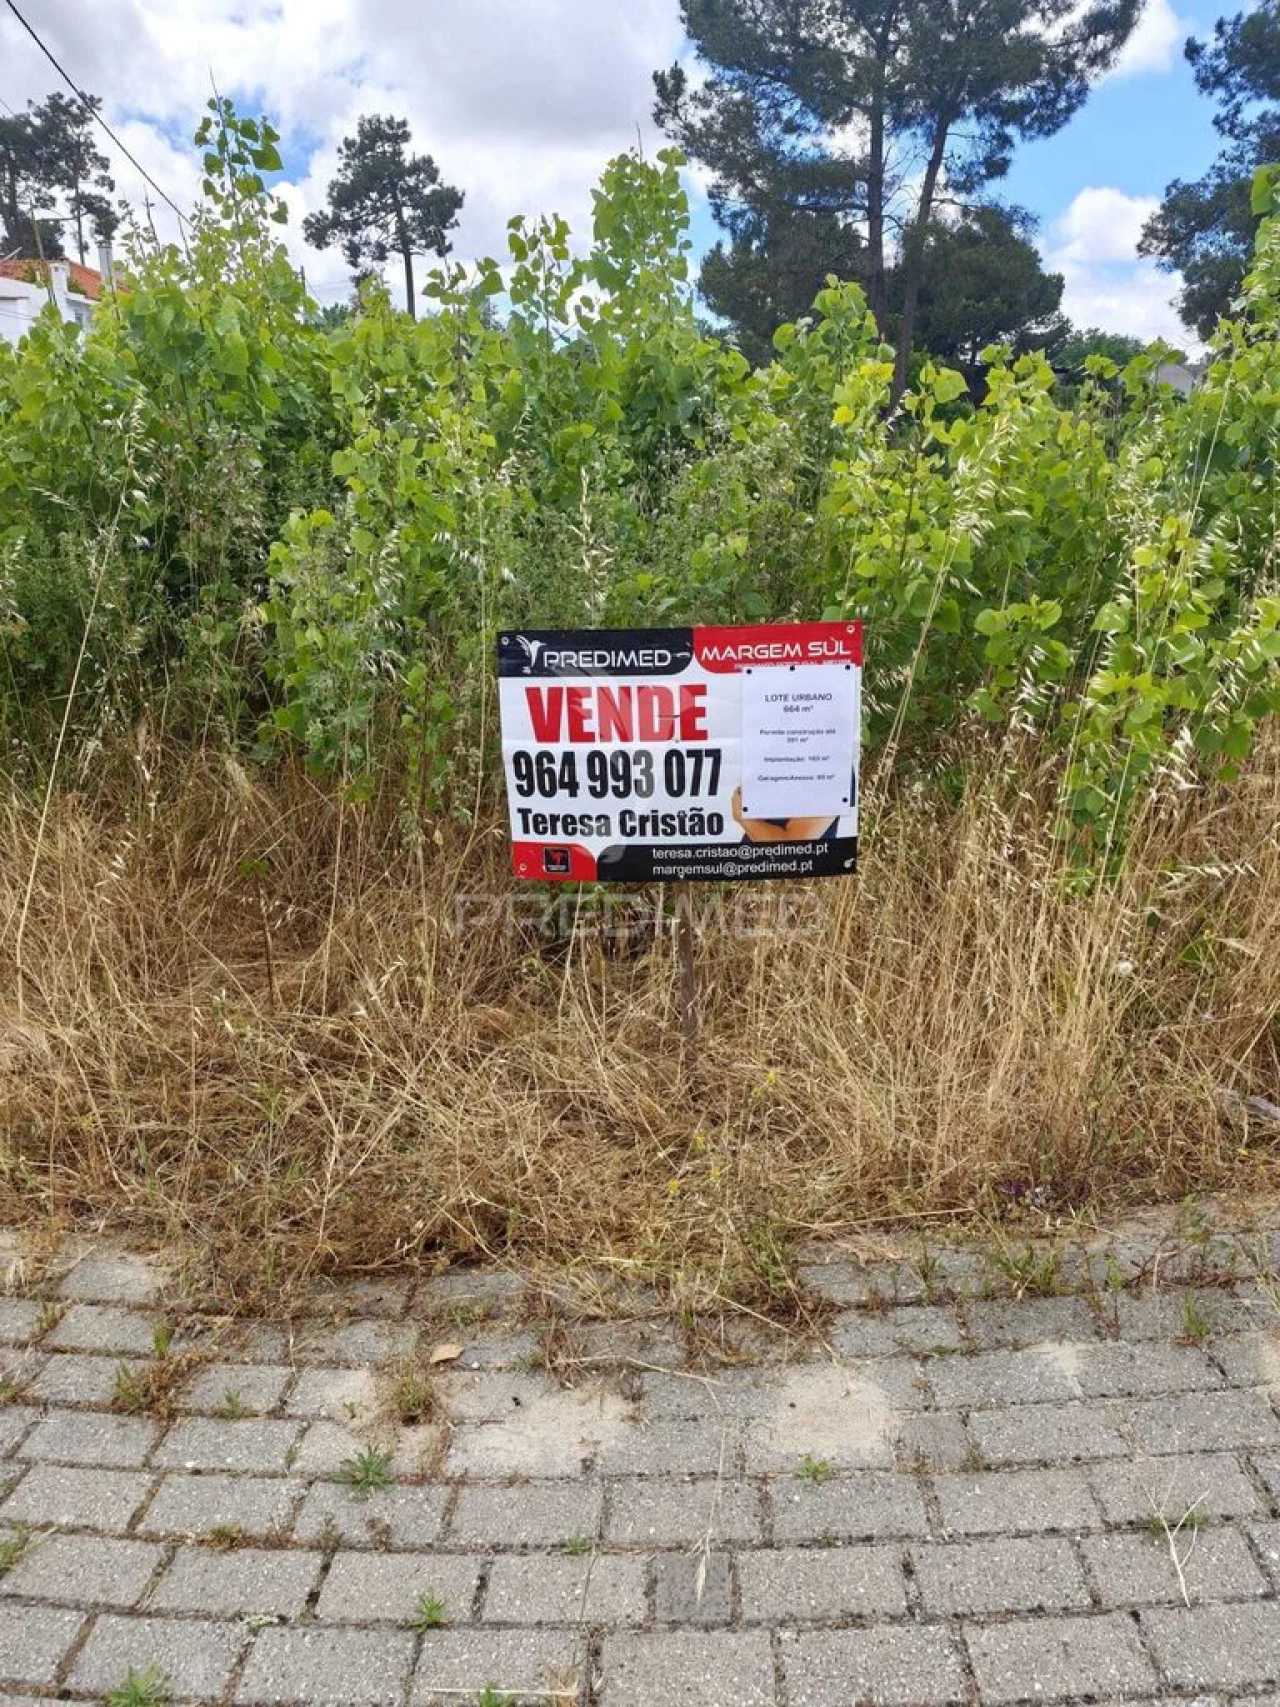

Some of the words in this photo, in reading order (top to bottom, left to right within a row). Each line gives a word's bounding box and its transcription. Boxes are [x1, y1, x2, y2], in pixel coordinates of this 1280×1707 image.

[543, 650, 671, 669] PREDIMED
[701, 643, 802, 661] MARGEM
[764, 694, 789, 703] LOTE
[791, 692, 833, 702] URBANO
[525, 684, 708, 743] VENDE
[513, 750, 579, 799] 964
[586, 750, 655, 798] 993
[663, 748, 722, 798] 077
[517, 808, 612, 836] Teresa
[619, 806, 724, 837] Cristão
[652, 841, 829, 860] teresa.cristao@predimed.pt
[652, 859, 814, 878] margemsul@predimed.pt
